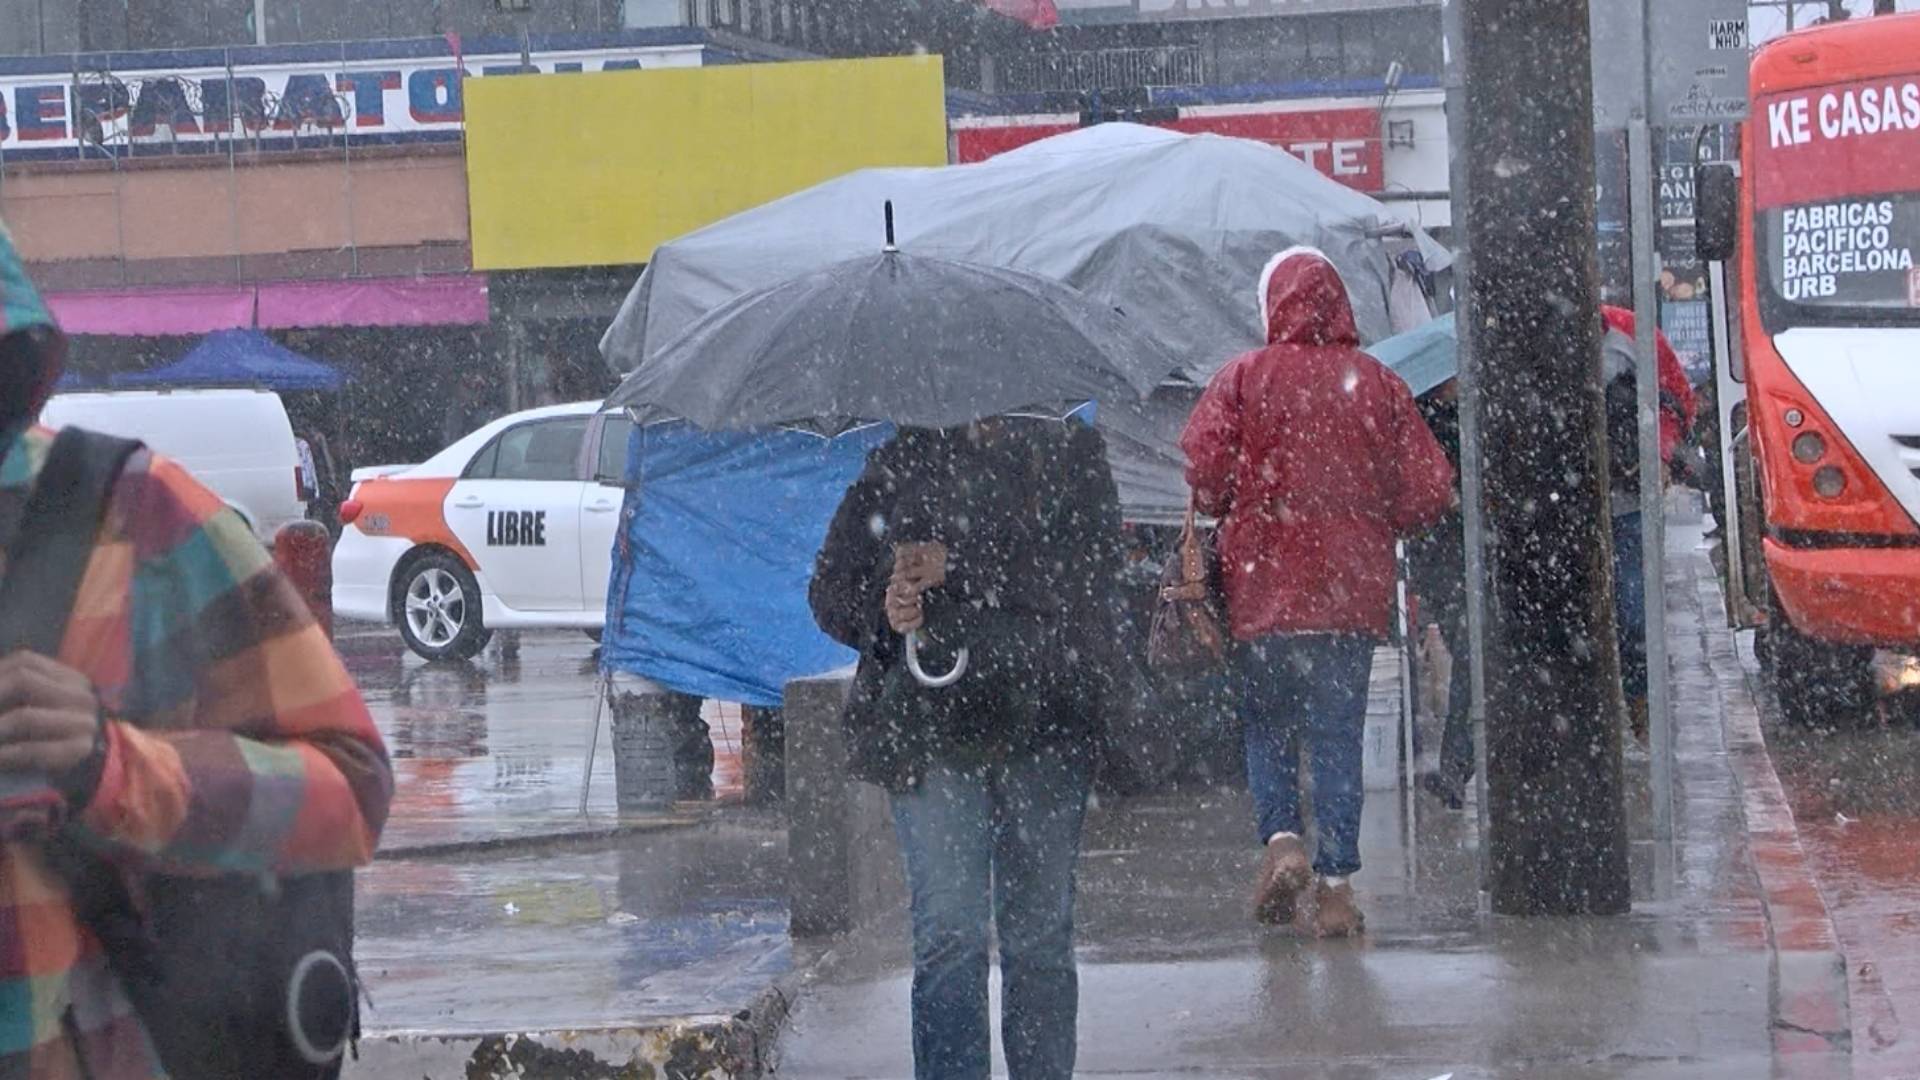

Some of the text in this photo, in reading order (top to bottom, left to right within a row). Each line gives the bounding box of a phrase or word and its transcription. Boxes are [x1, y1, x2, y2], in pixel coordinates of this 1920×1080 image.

[1768, 83, 1920, 149] KE CASAS
[1660, 181, 1696, 199] AN
[1783, 201, 1893, 233] FABRICAS
[1783, 226, 1889, 257] PACIFICO
[1783, 248, 1913, 279] BARCELONA
[1783, 275, 1837, 300] URB
[487, 511, 546, 546] LIBRE
